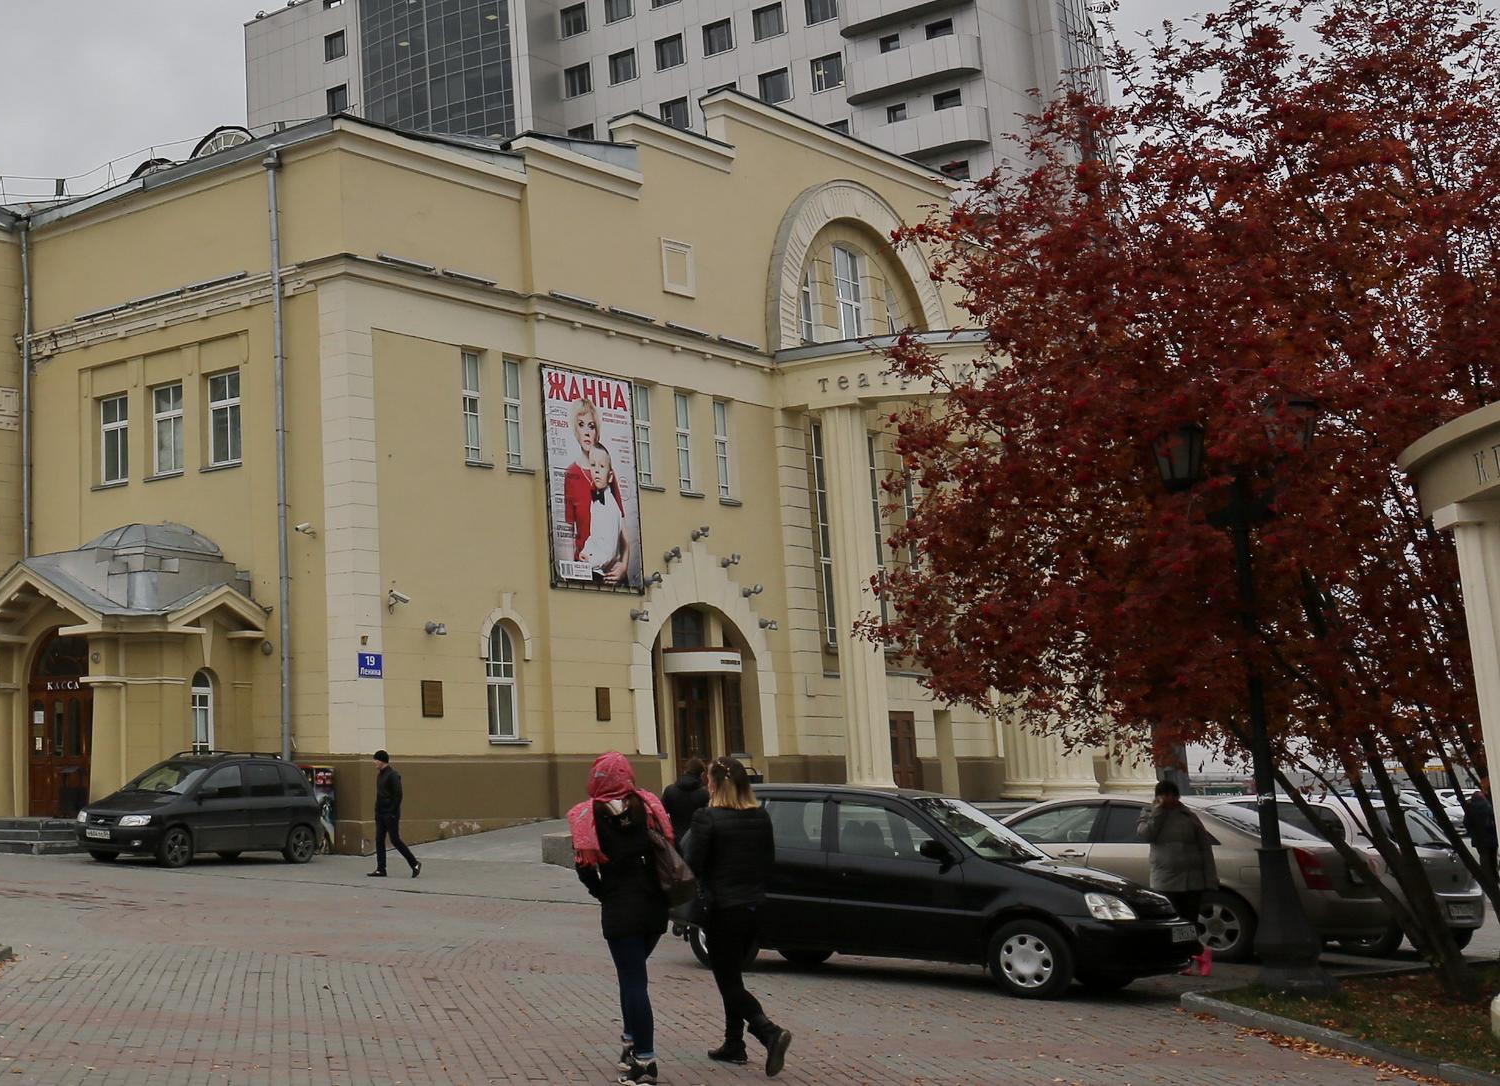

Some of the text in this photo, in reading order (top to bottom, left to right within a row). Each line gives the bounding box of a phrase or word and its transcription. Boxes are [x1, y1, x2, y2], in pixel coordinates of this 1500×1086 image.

[547, 371, 628, 412] ЖАННА
[365, 655, 376, 666] 19
[360, 667, 381, 676] Ленина
[47, 680, 80, 691] КАССА
